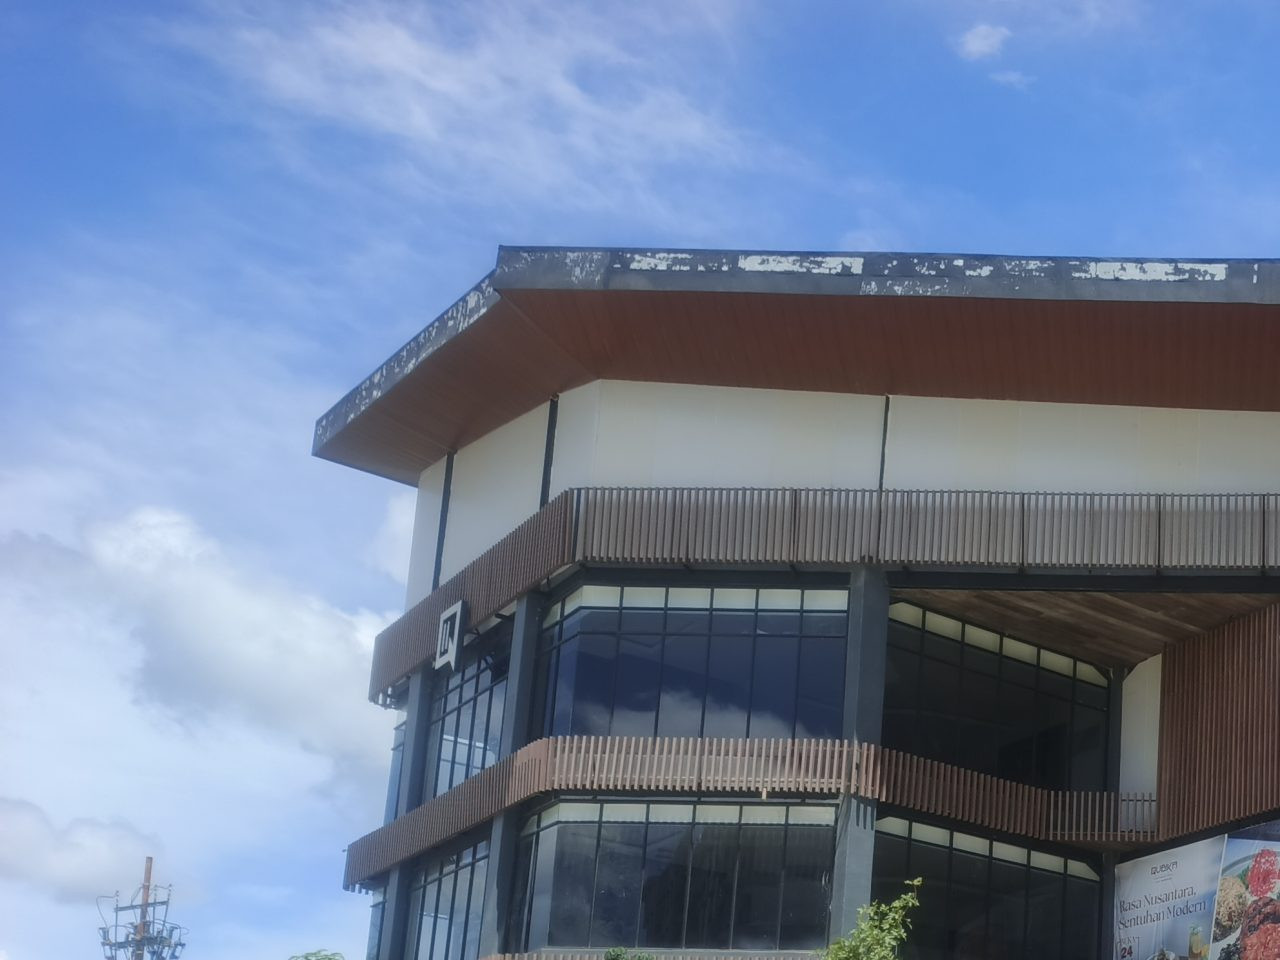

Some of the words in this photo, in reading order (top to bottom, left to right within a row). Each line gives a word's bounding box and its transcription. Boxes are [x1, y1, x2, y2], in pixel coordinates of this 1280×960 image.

[1120, 899, 1142, 914] Rasa
[1144, 886, 1197, 907] Nusantara,
[1118, 909, 1165, 931] Sentuhan
[1166, 900, 1206, 920] Modern
[1120, 945, 1133, 960] 24
